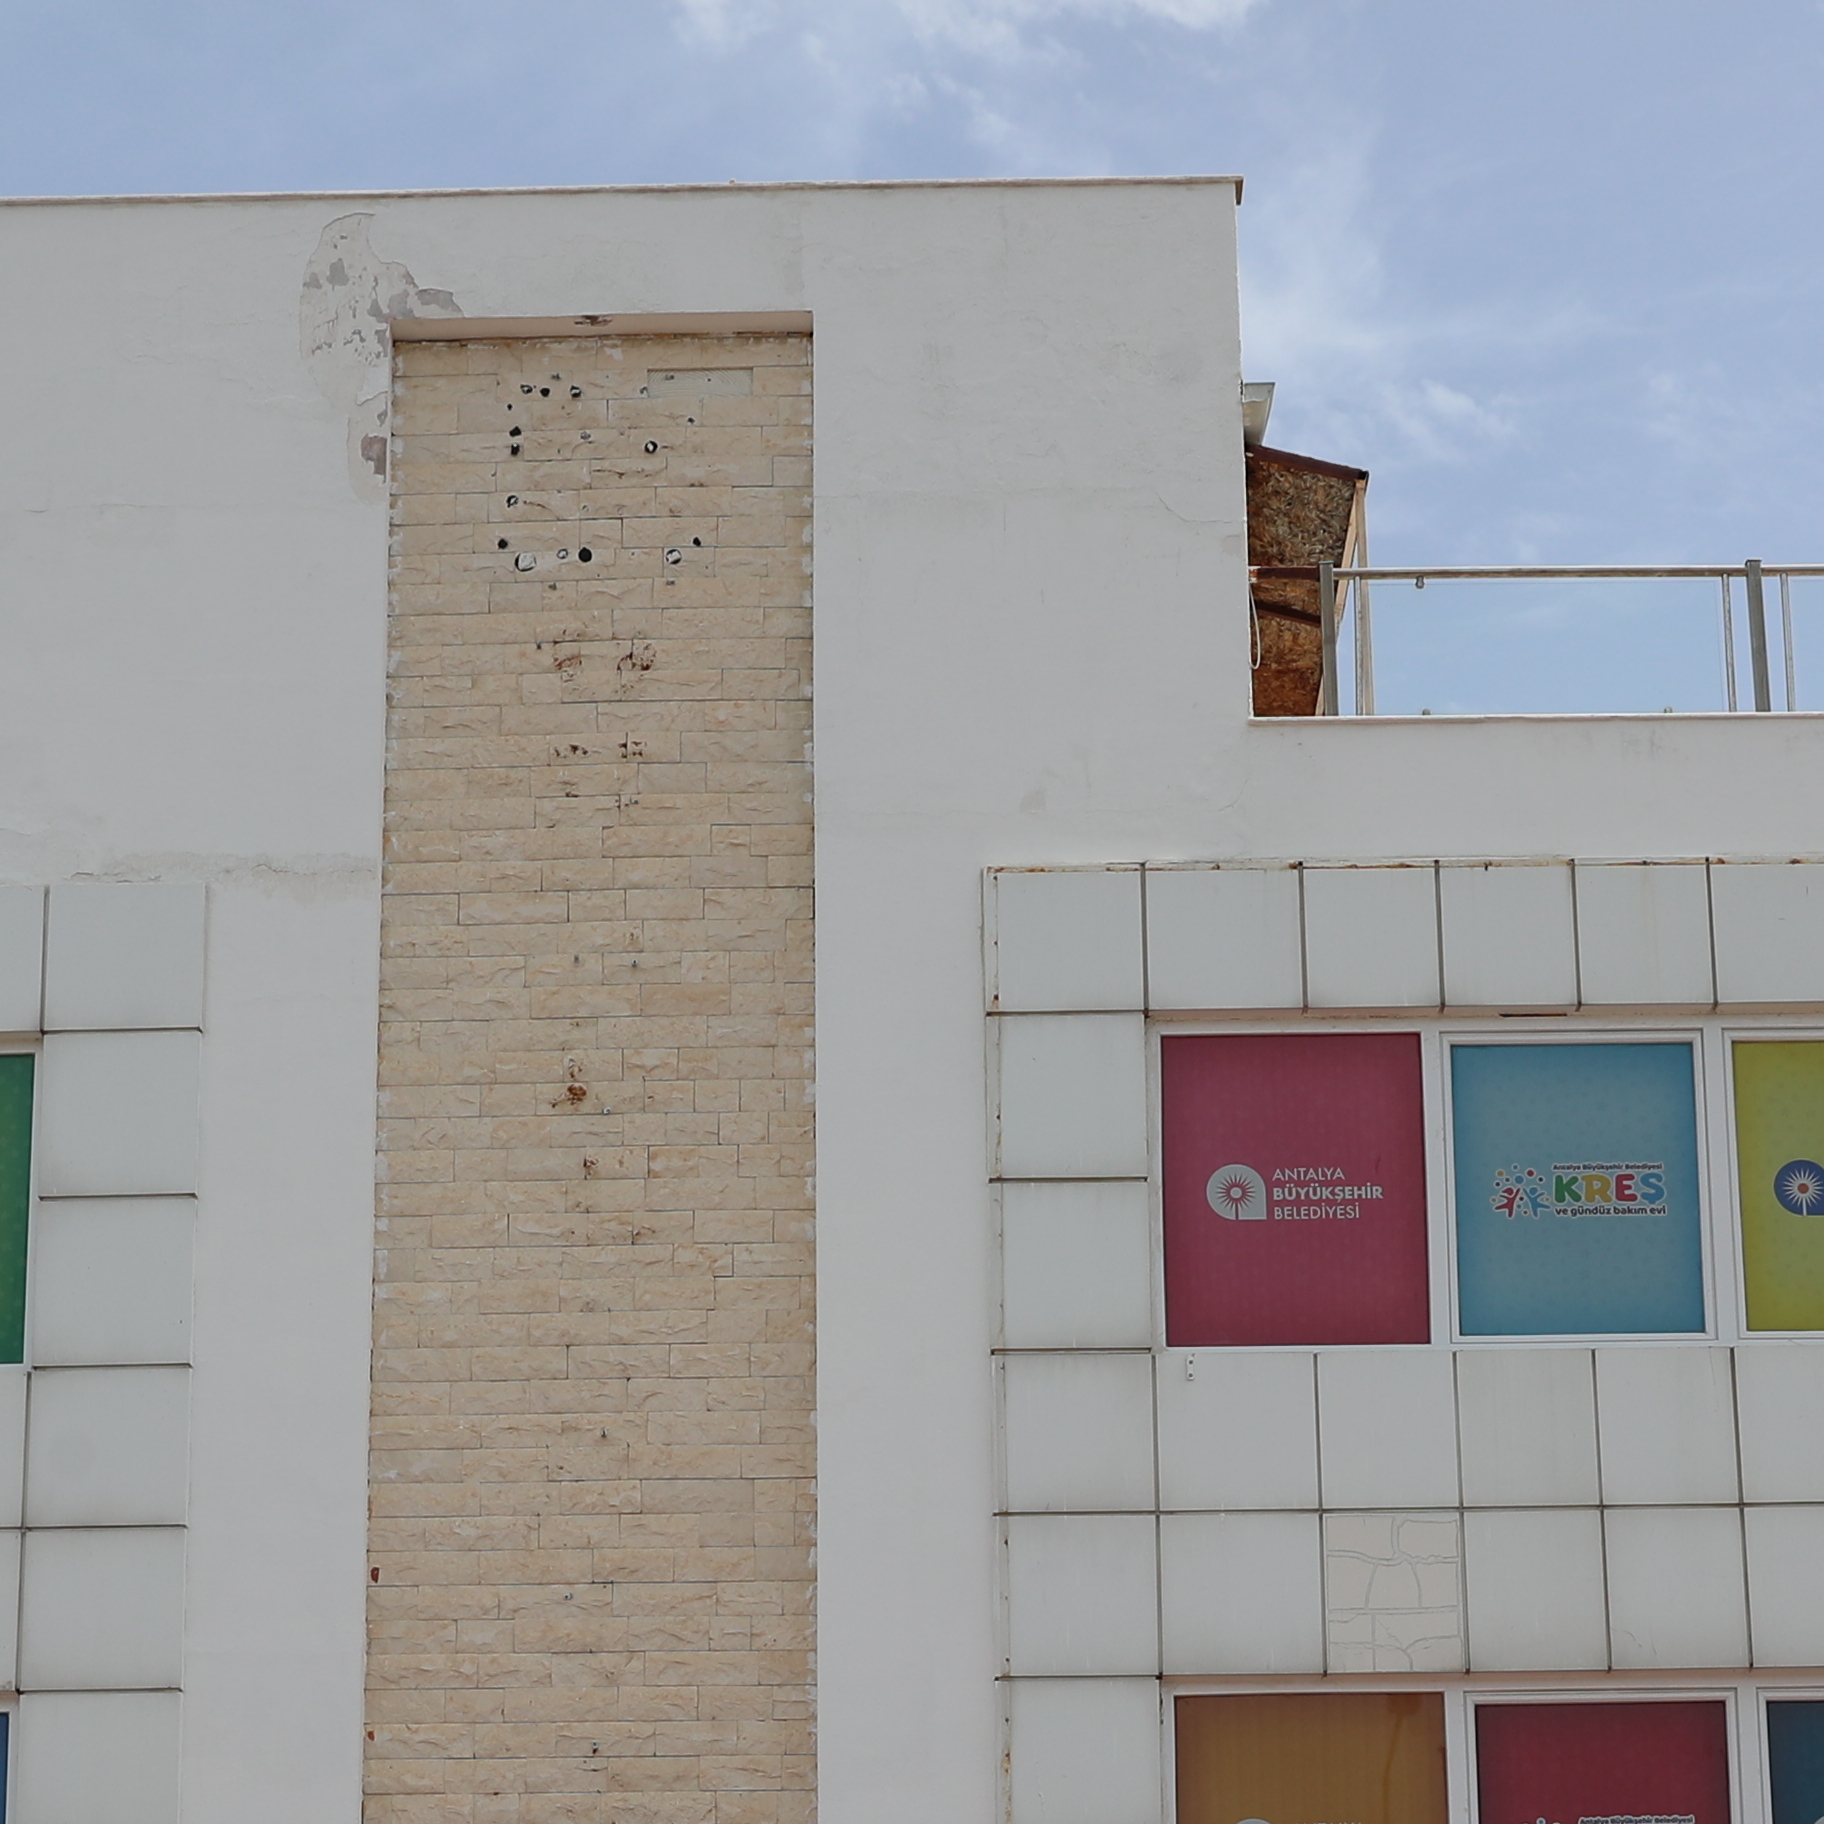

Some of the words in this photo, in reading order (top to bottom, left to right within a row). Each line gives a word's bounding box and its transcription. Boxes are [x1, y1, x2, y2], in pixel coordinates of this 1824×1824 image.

[1272, 1167, 1345, 1181] ANTALYA
[1273, 1182, 1383, 1203] BÜYÜKŞEHİR
[1554, 1173, 1666, 1204] KREŞ
[1275, 1203, 1359, 1219] BELEDİYESİ
[1555, 1207, 1568, 1215] ve
[1571, 1206, 1611, 1217] gündüz
[1614, 1206, 1647, 1214] bakım
[1650, 1206, 1666, 1214] evi
